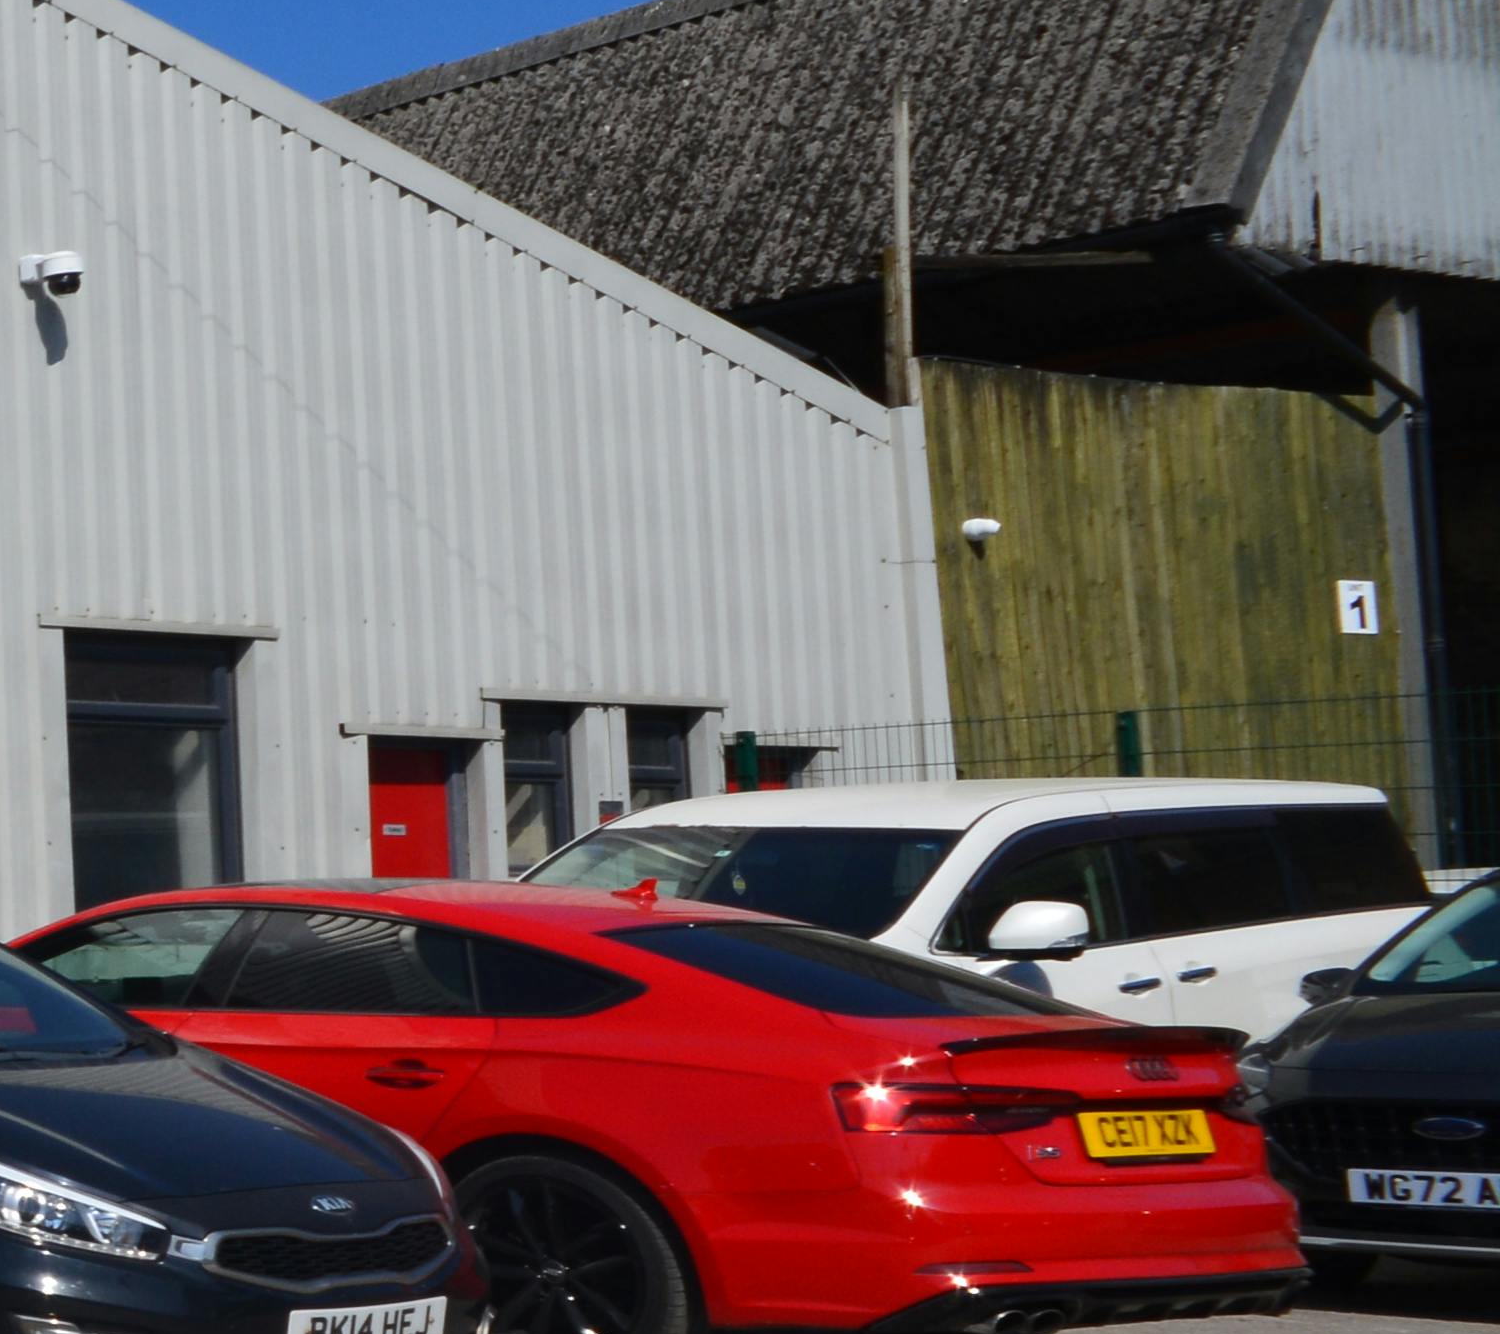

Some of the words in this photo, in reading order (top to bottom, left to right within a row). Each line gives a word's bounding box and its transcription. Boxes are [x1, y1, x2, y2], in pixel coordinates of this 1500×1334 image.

[1350, 595, 1367, 629] 1
[1097, 1115, 1150, 1148] CE17
[1152, 1114, 1200, 1146] XZK
[1363, 1172, 1465, 1204] WG72
